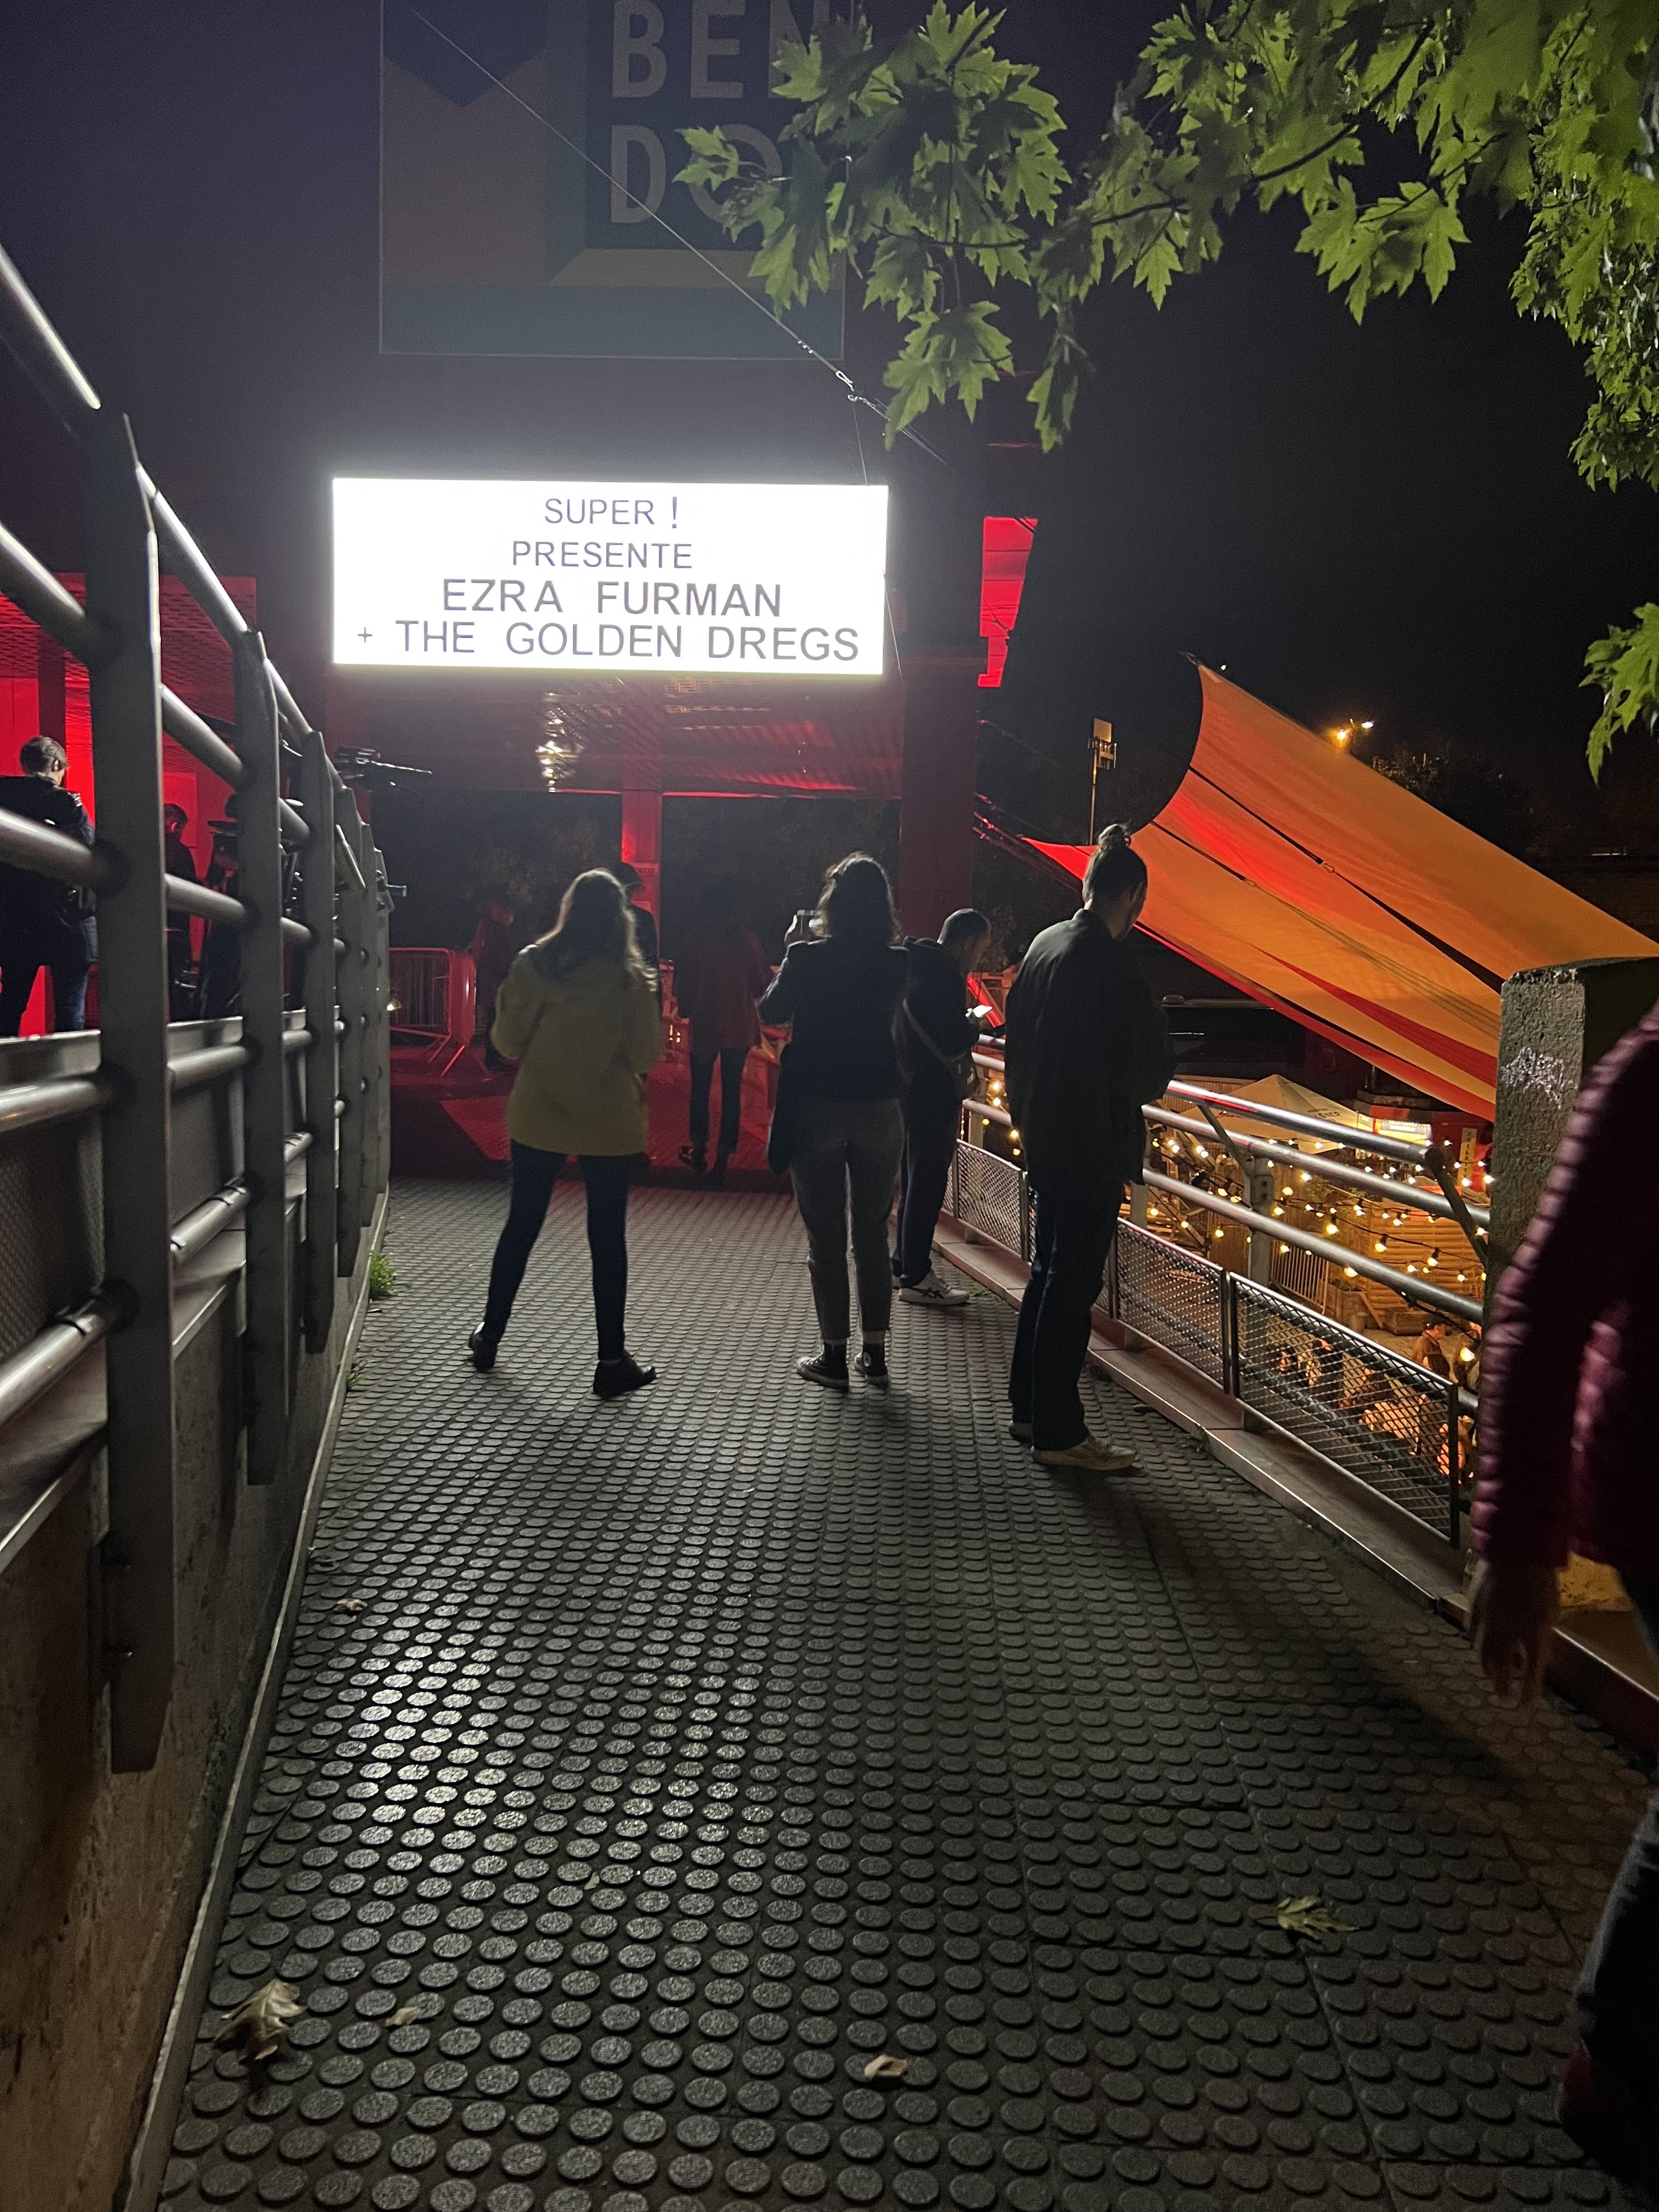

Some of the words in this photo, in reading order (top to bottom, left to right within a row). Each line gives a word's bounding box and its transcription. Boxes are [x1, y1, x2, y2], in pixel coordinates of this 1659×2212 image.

[544, 498, 656, 526] SUPER
[512, 540, 693, 569] PRESENTE
[443, 578, 564, 613] EZRA
[597, 580, 781, 618] FURMAN
[394, 619, 476, 654] THE
[505, 621, 682, 658] GOLDEN
[708, 625, 859, 662] DREGS
